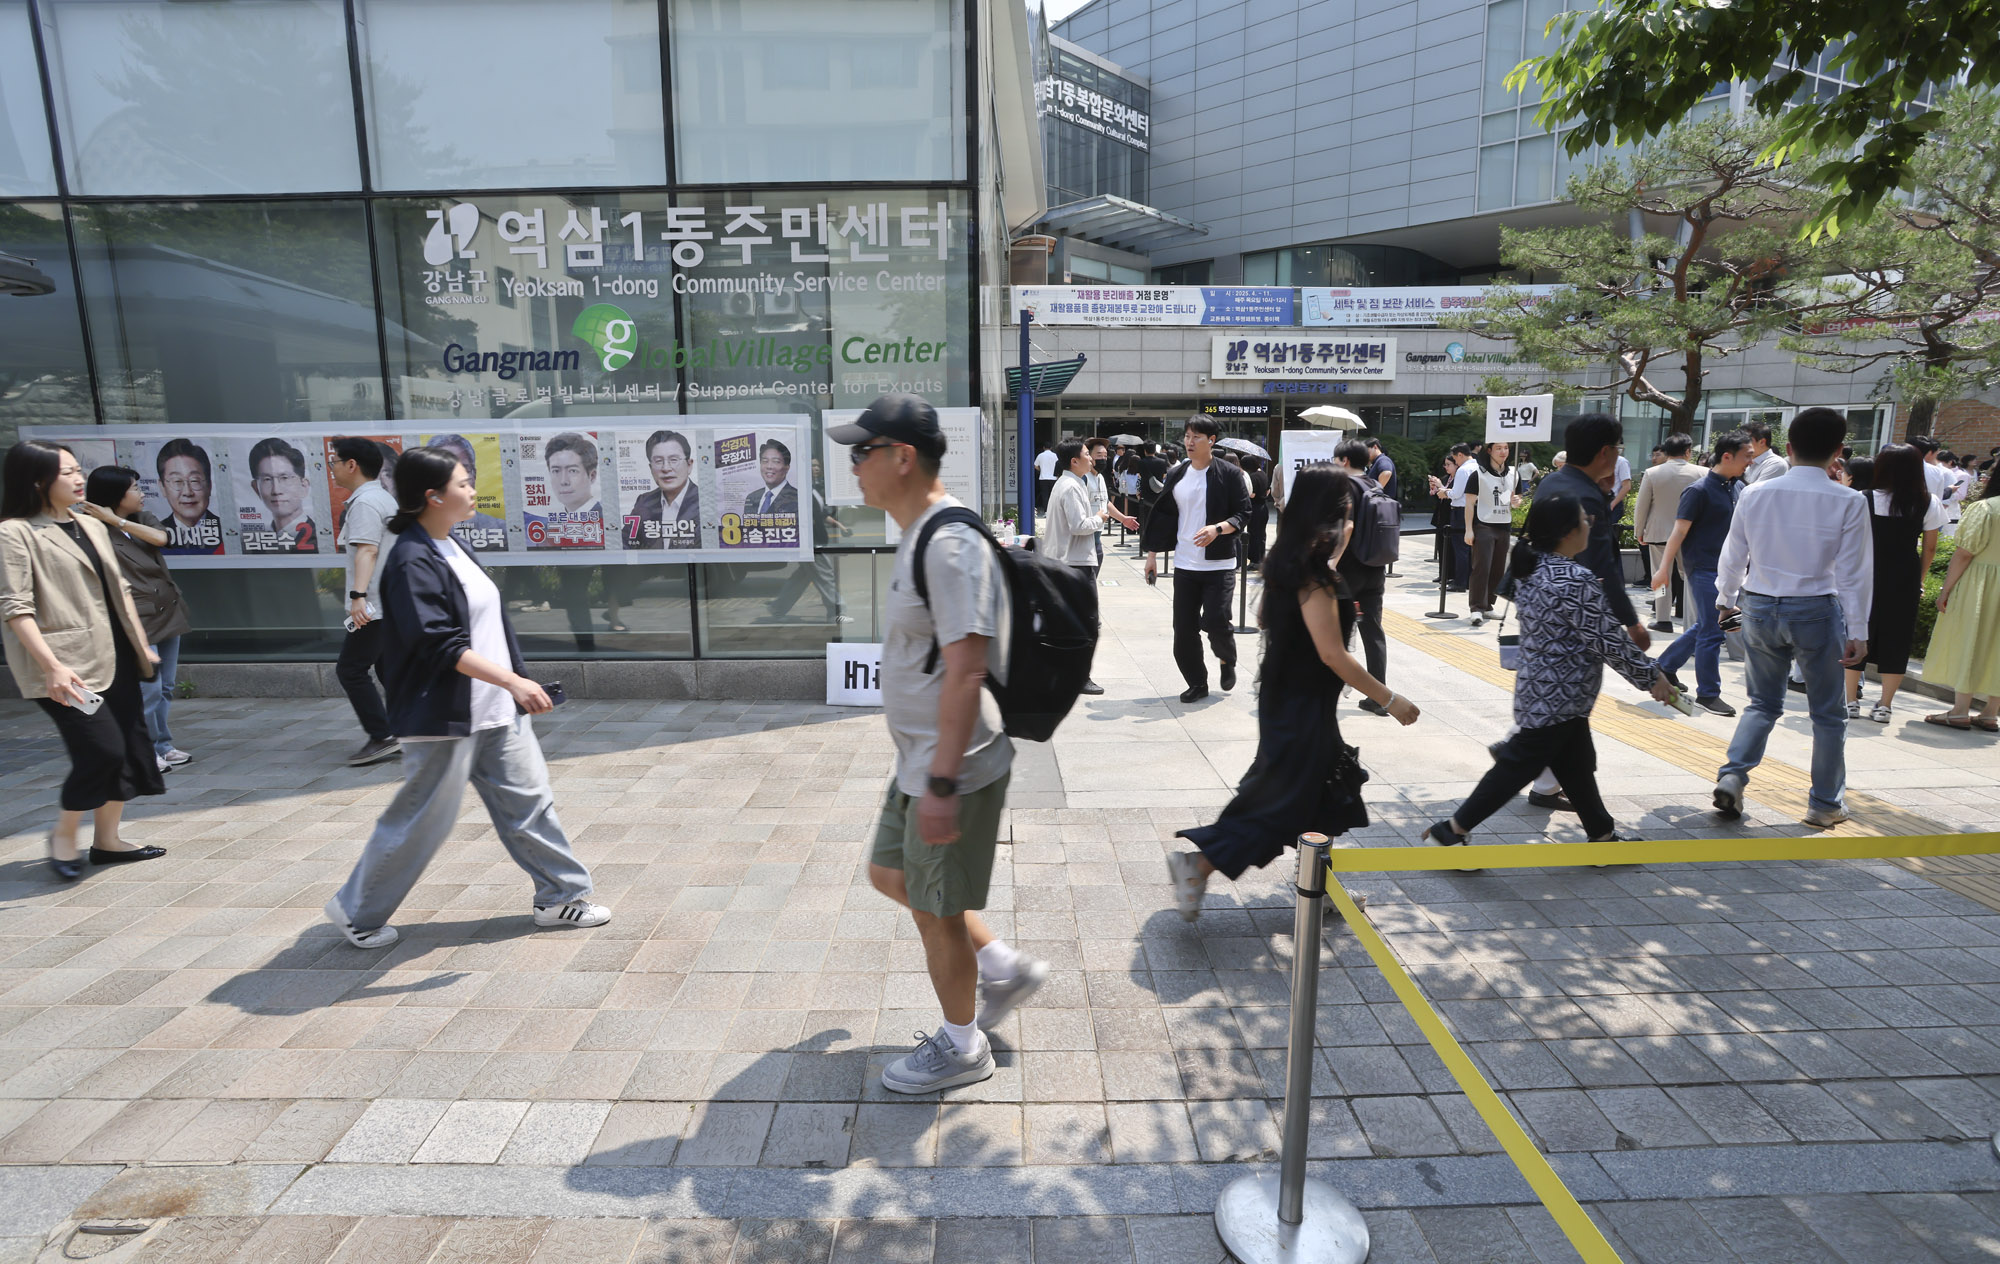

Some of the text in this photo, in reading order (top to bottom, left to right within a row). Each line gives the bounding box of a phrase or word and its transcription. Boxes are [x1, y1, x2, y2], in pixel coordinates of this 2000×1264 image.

[1075, 113, 1105, 134] Community
[1106, 126, 1126, 140] Cultural
[1127, 134, 1147, 149] Complex
[497, 201, 948, 269] 역삼1동주민센터
[423, 269, 488, 293] 강남구
[502, 270, 946, 299] Yeoksam 1-dong Community Service Center
[1050, 302, 1089, 313] 재활용품을
[1165, 304, 1197, 314] 드립니다
[1333, 298, 1355, 310] 세탁
[1382, 298, 1402, 309] 보관
[1404, 297, 1436, 309] 서비스
[443, 343, 579, 380] Gangnam
[724, 336, 833, 374] Village
[842, 336, 947, 364] Center
[1253, 342, 1386, 363] 역삼1동주민센터
[1405, 352, 1446, 364] Gangnam
[1226, 363, 1248, 371] 강남구
[1254, 366, 1280, 374] Yeoksam
[1282, 366, 1303, 375] 1-dong
[1305, 366, 1339, 375] Community
[1340, 366, 1362, 374] Service
[1363, 367, 1384, 375] Center
[688, 381, 765, 399] Support
[772, 380, 835, 396] Center
[844, 382, 870, 394] for
[878, 378, 944, 395] Expats
[1275, 382, 1329, 394] 역삼로7길
[1499, 406, 1538, 428] 관외
[525, 484, 546, 495] 정치
[527, 496, 551, 506] 교체!
[167, 526, 221, 546] 이재명
[242, 521, 315, 551] 김문수 2
[527, 520, 604, 543] 6 구주와
[623, 514, 696, 539] 7 황교안
[721, 512, 797, 545] 8 송진호
